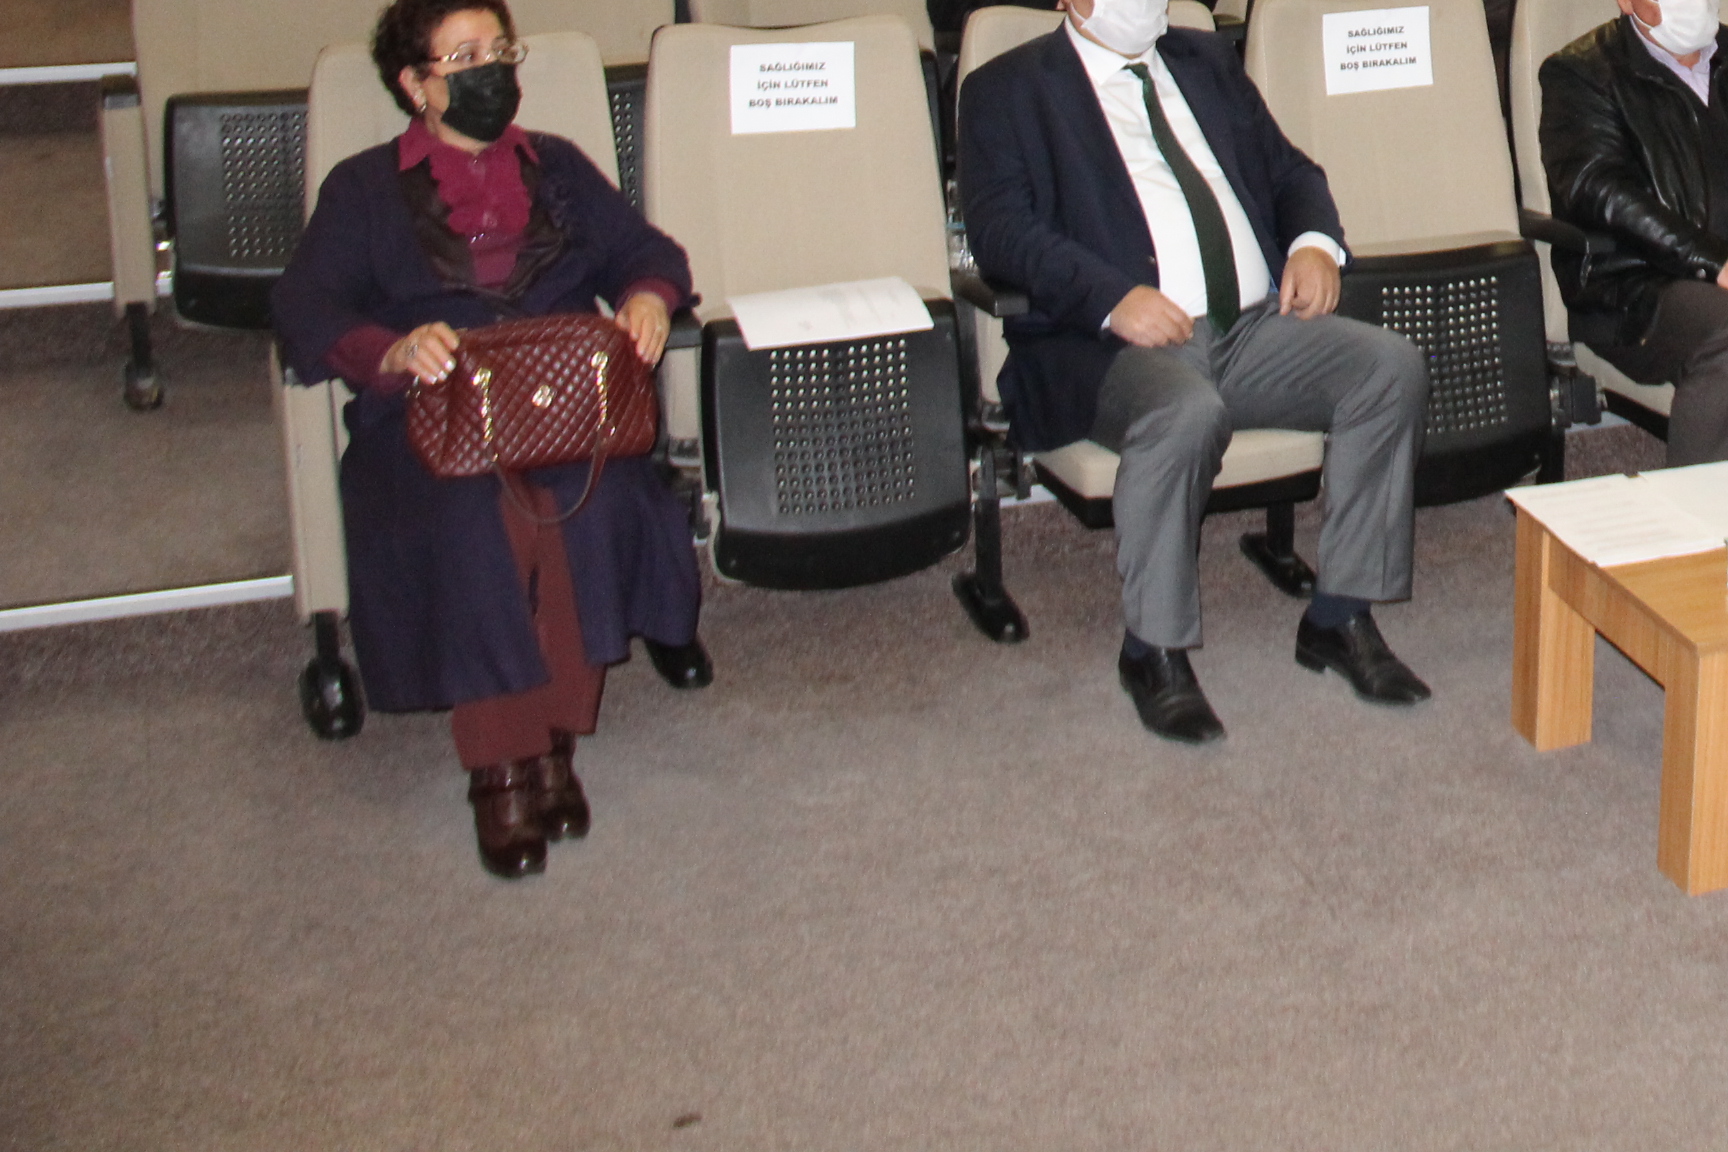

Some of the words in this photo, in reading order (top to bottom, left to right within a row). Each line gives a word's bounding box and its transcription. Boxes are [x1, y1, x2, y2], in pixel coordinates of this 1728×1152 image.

[1348, 26, 1404, 38] SAĞLIĞIMIZ
[1347, 45, 1366, 55] İÇİN
[1370, 42, 1407, 52] LÜTFEN
[760, 62, 825, 72] SAĞLIĞIMIZ
[1340, 62, 1359, 71] BOŞ
[1362, 57, 1416, 68] BIRAKALIM
[757, 80, 780, 91] İÇİN
[784, 80, 828, 88] LÜTFEN
[749, 99, 771, 108] BOŞ
[775, 97, 838, 106] BIRAKALIM
